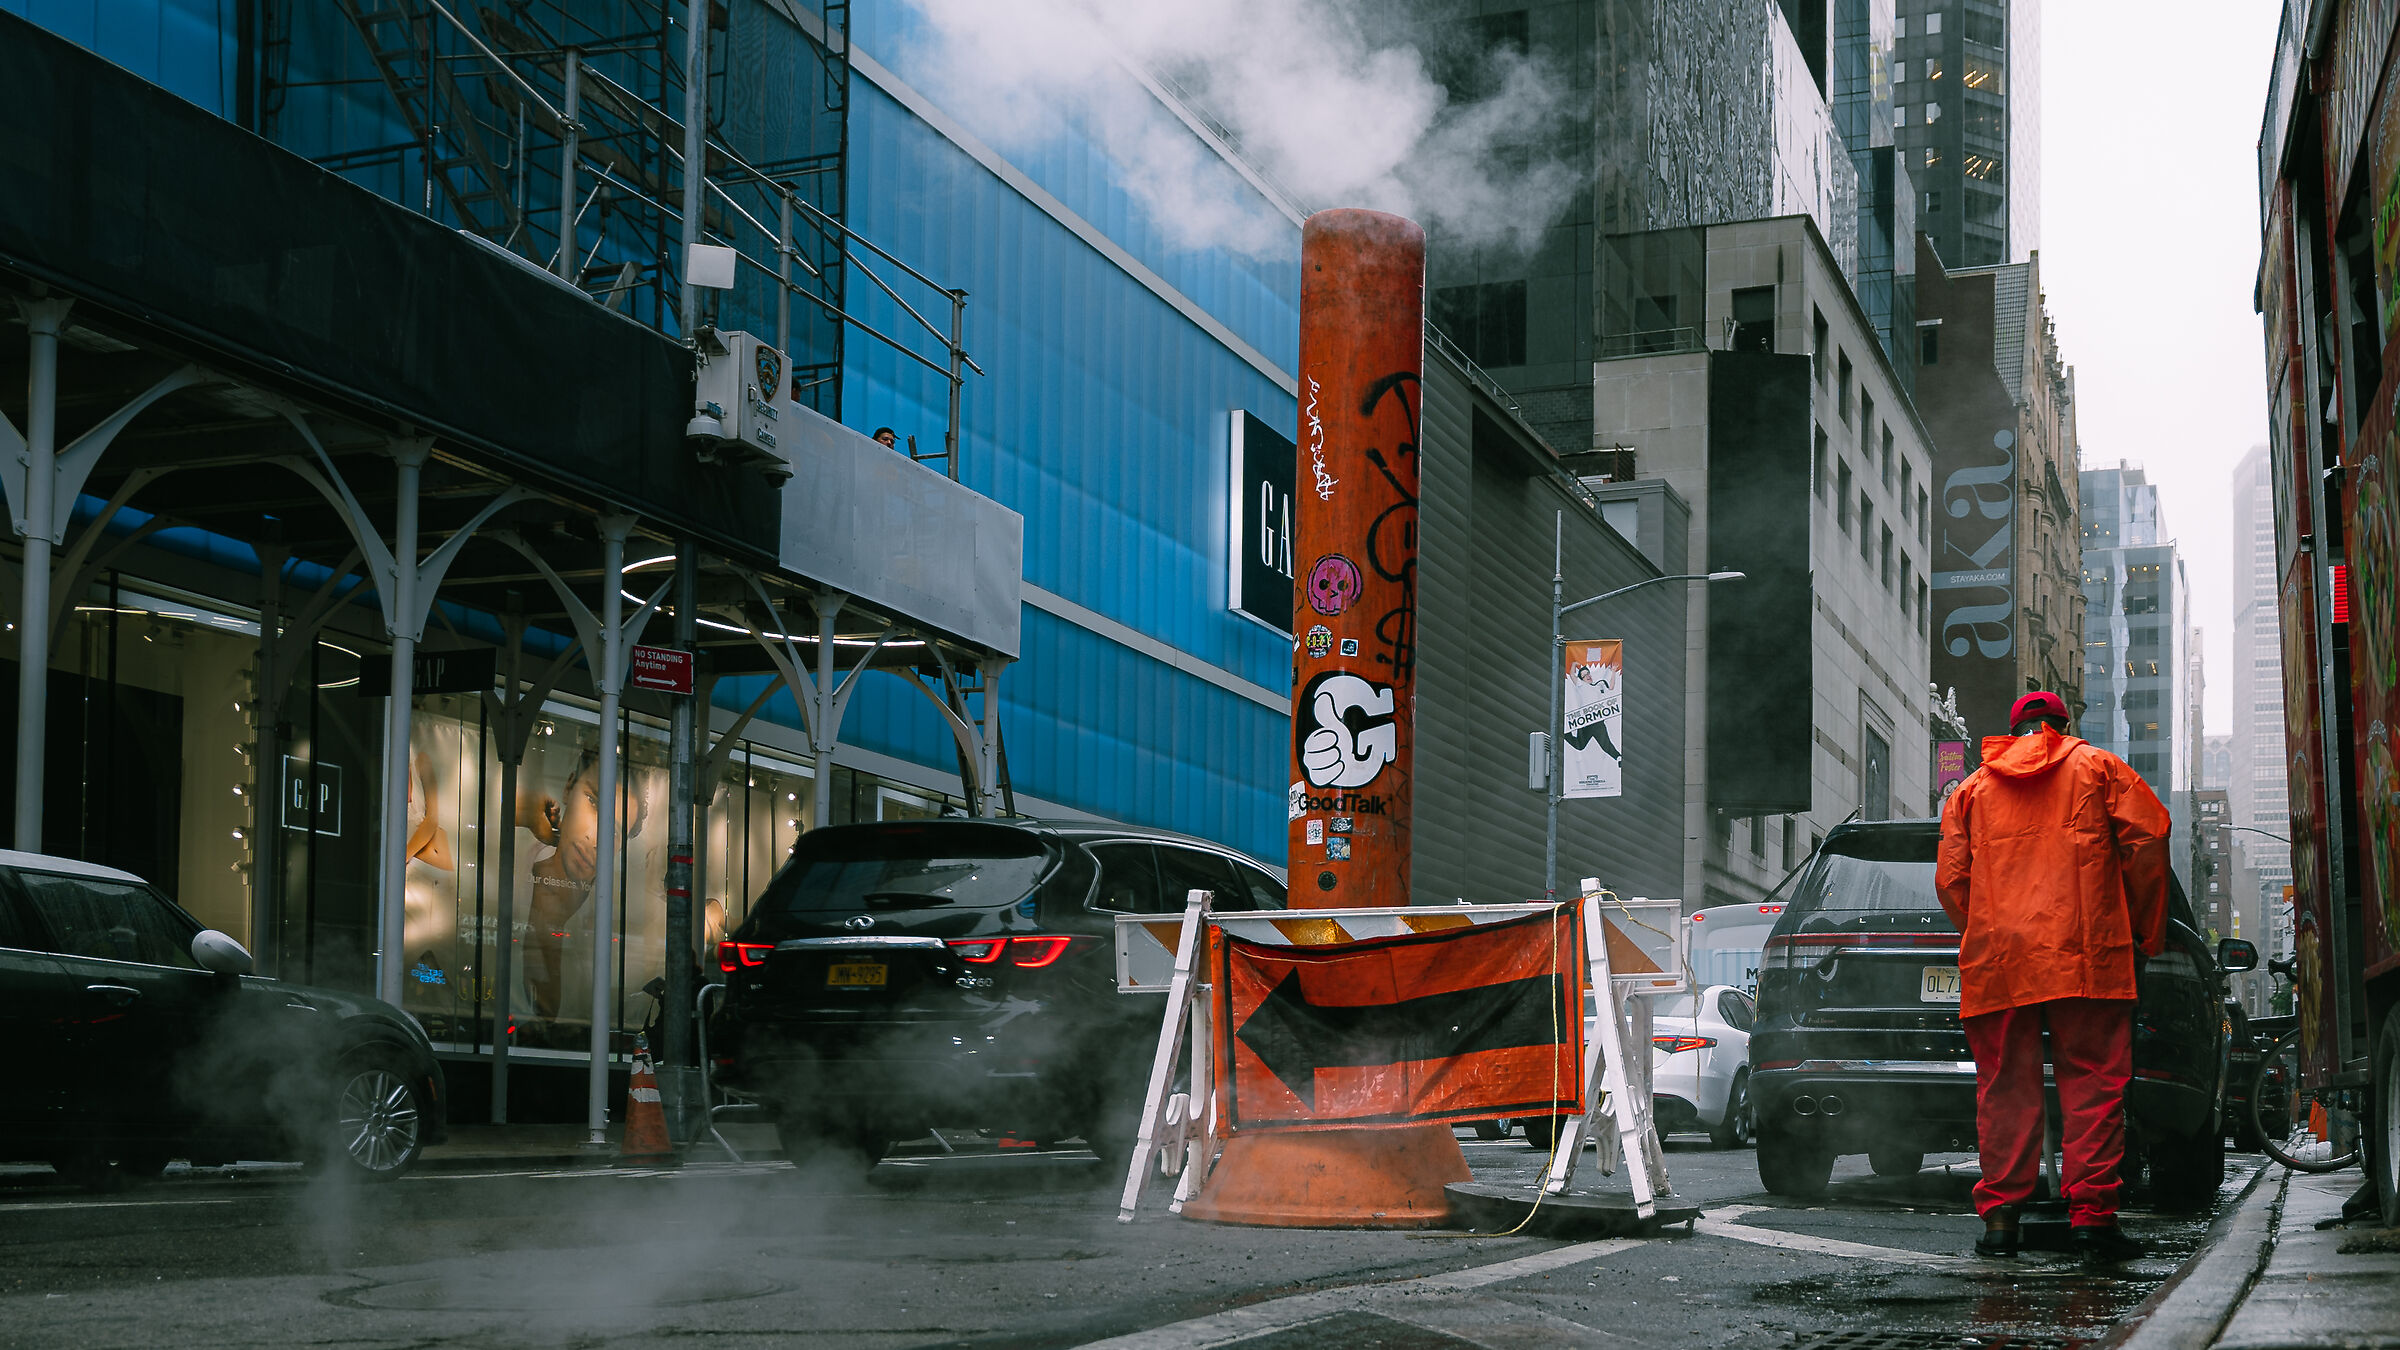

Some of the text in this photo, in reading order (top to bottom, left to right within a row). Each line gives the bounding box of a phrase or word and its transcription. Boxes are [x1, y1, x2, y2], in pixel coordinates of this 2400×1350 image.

[1950, 572, 2006, 584] STAYAKA.COM
[635, 649, 683, 664] NO STANDING
[635, 659, 667, 671] Anytime
[1567, 698, 1617, 720] THE BOOK OF
[1568, 704, 1620, 729] MORMON
[1298, 793, 1387, 816] GoodTalk
